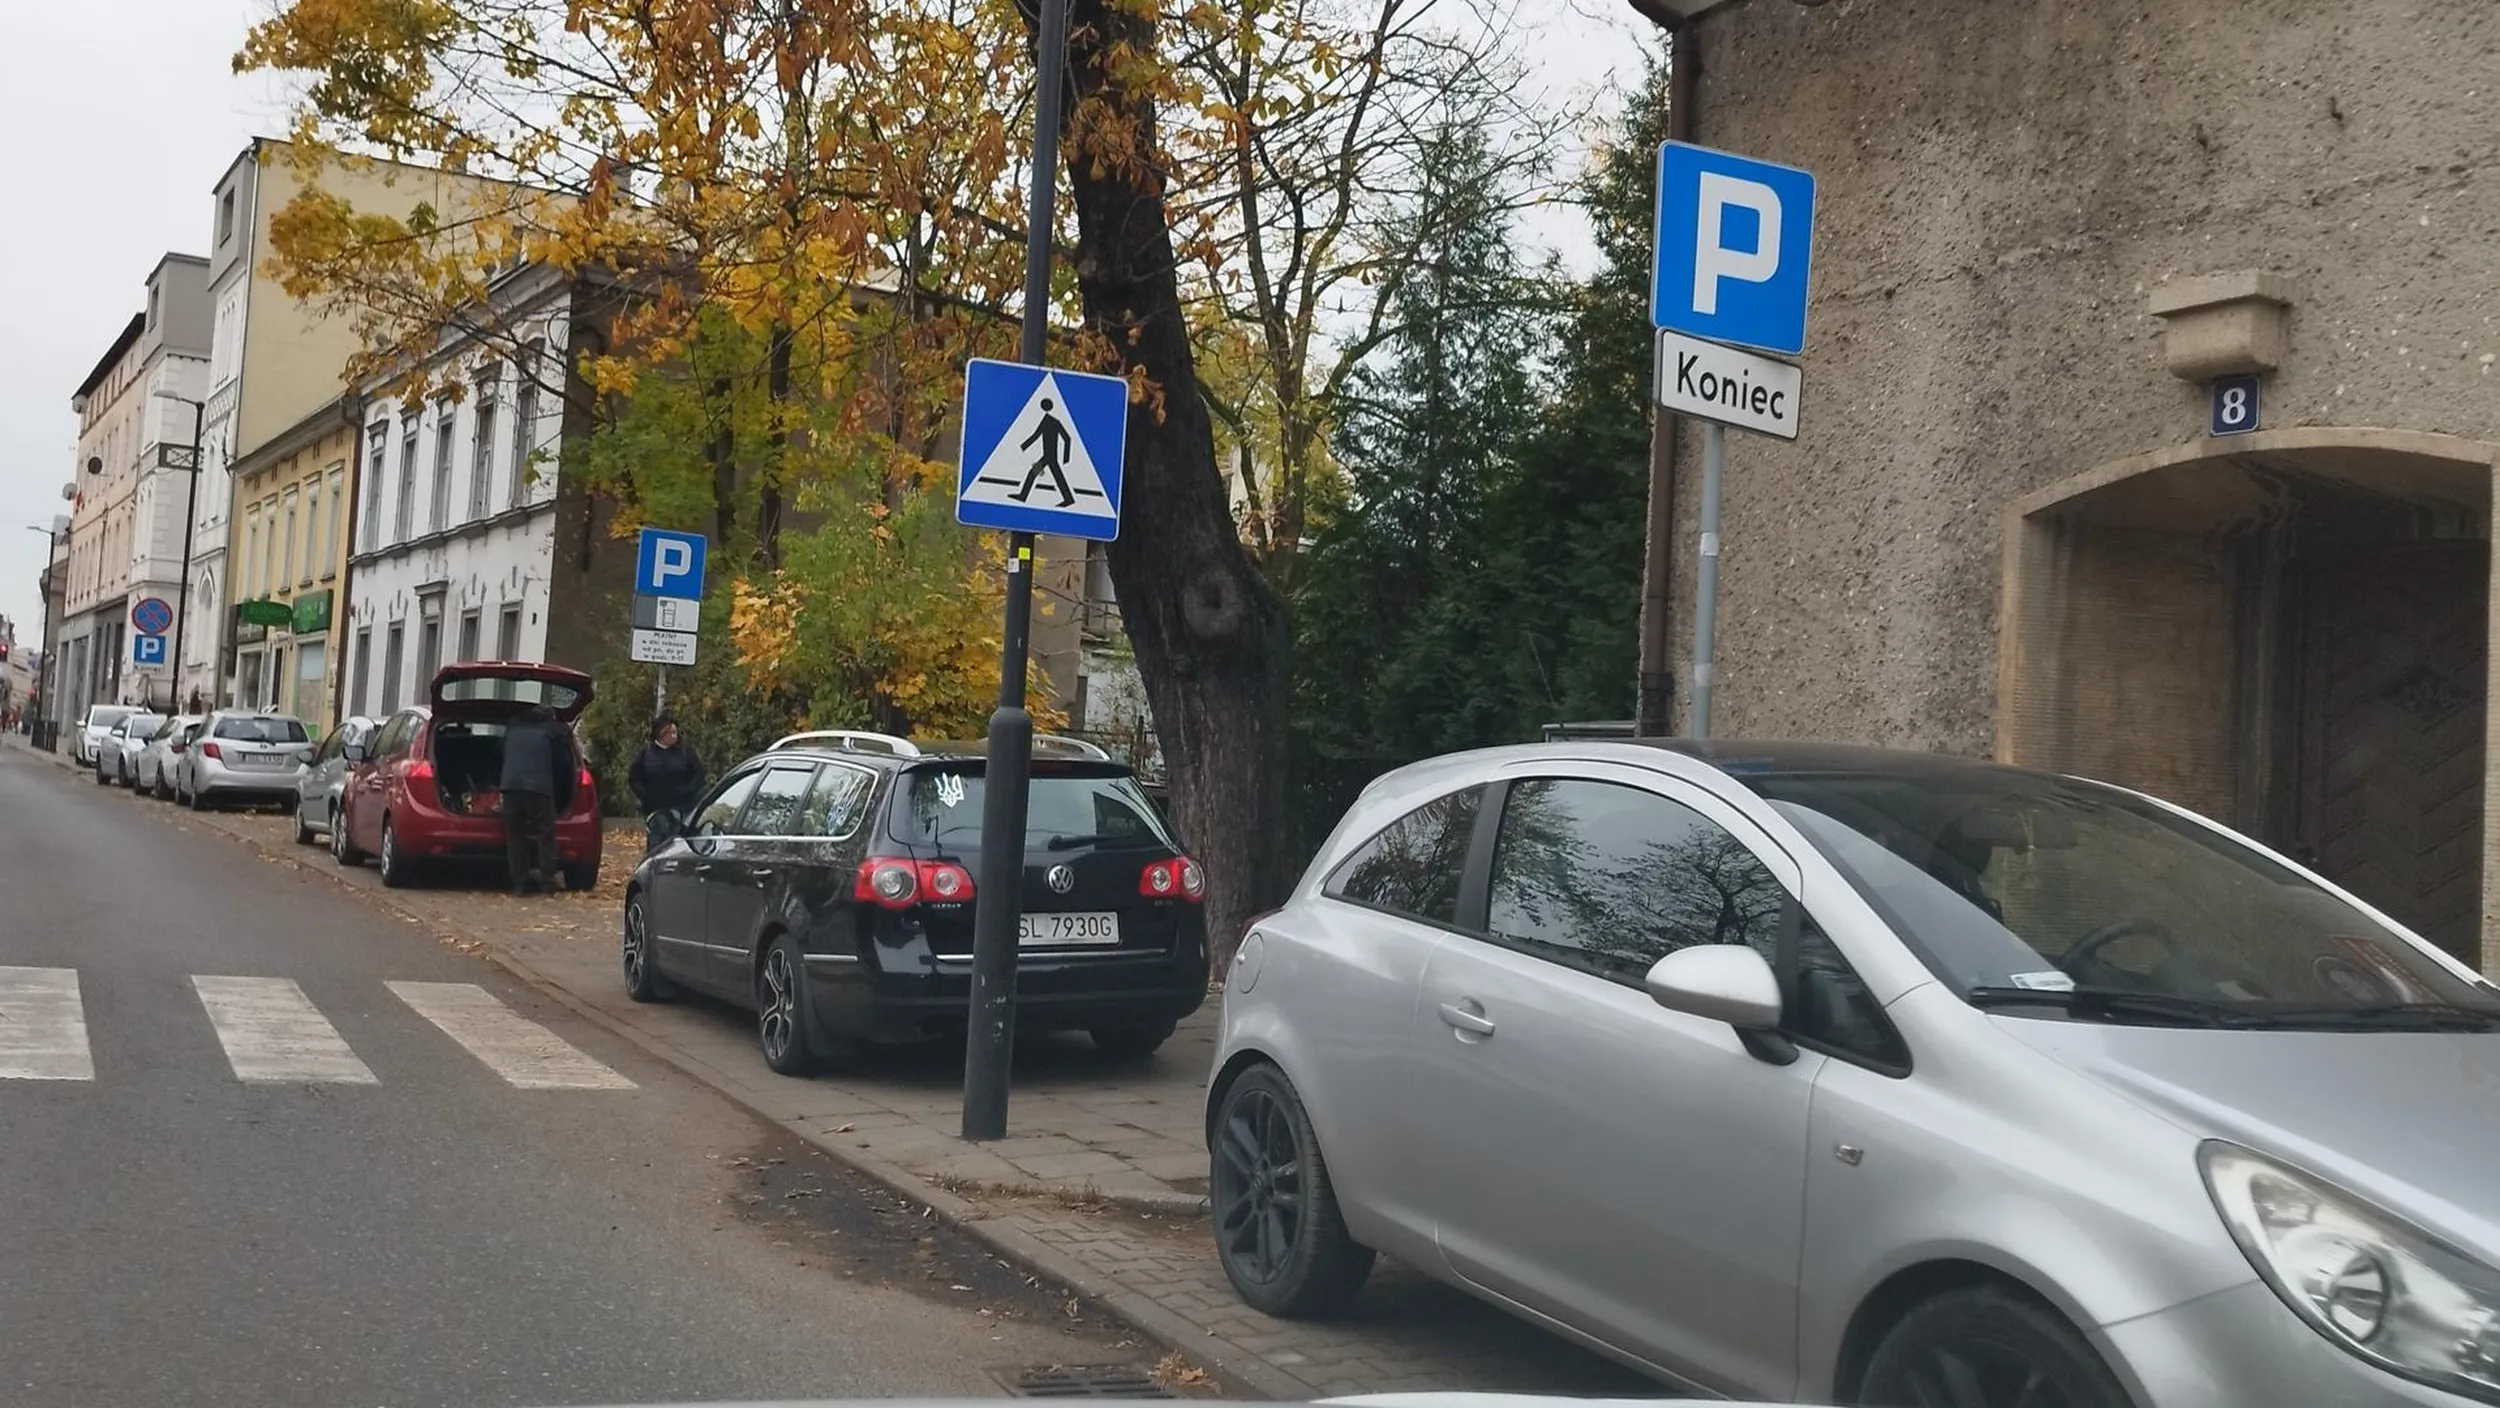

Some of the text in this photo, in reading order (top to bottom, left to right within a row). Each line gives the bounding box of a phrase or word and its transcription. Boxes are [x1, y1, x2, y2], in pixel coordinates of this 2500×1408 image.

[1692, 171, 1782, 315] P
[1676, 351, 1785, 420] Koniec
[2222, 387, 2246, 424] 8
[653, 538, 692, 588] P
[140, 637, 160, 659] P
[1019, 916, 1112, 938] SL 7930G
